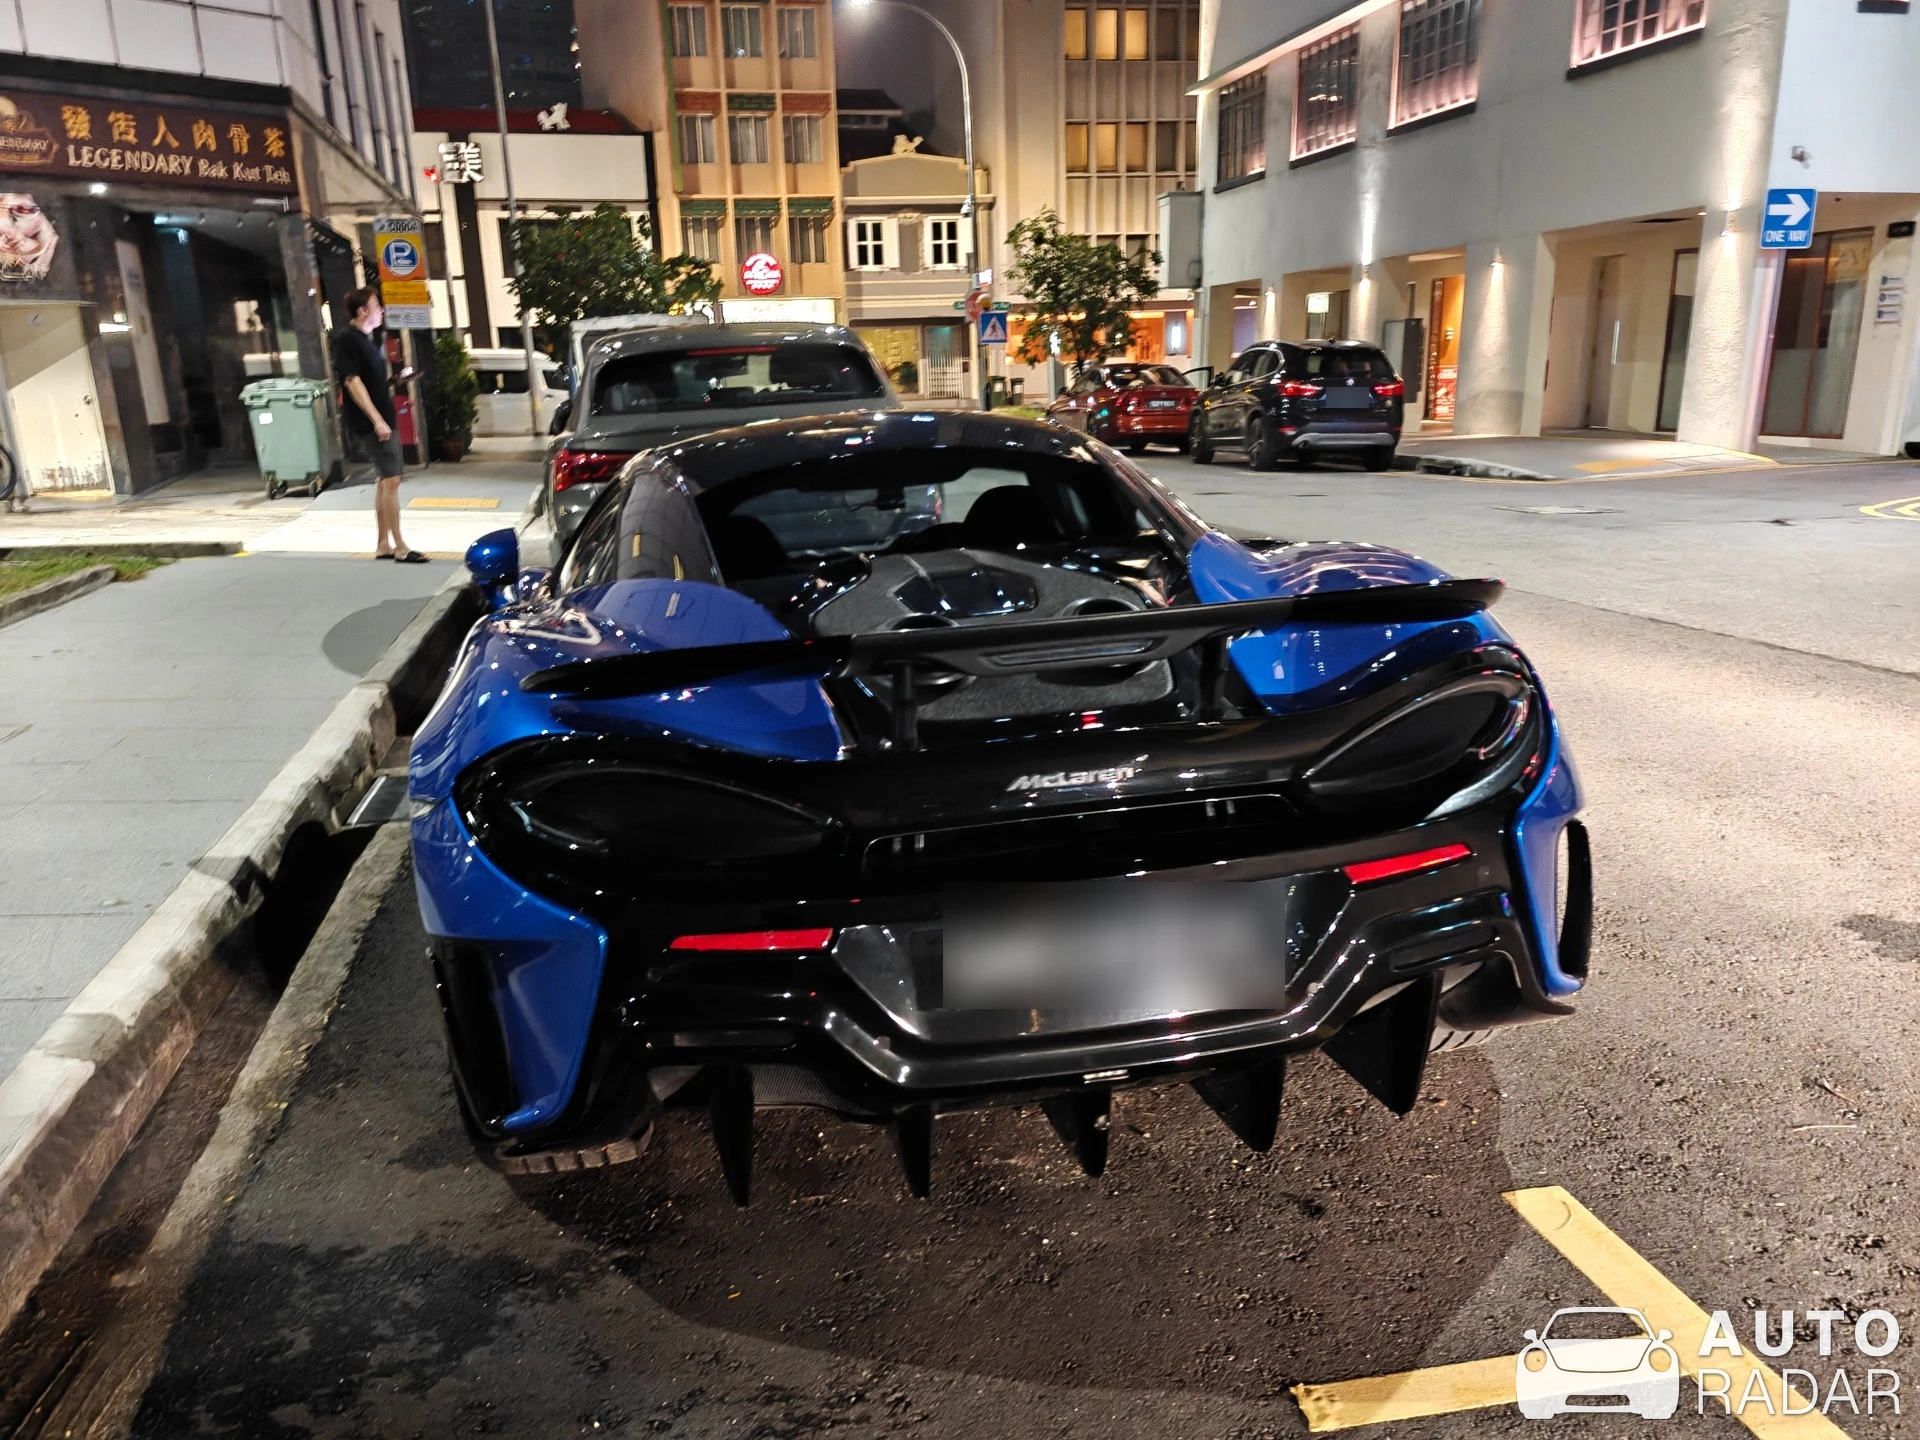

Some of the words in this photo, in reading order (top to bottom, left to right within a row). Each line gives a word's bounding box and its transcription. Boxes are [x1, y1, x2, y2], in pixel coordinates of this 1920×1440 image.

[67, 144, 193, 176] LEGENDARY
[198, 158, 228, 178] Bak
[232, 162, 261, 182] Kut
[1765, 230, 1786, 242] ONE
[1787, 230, 1808, 242] WAY
[1006, 767, 1135, 792] McLaren
